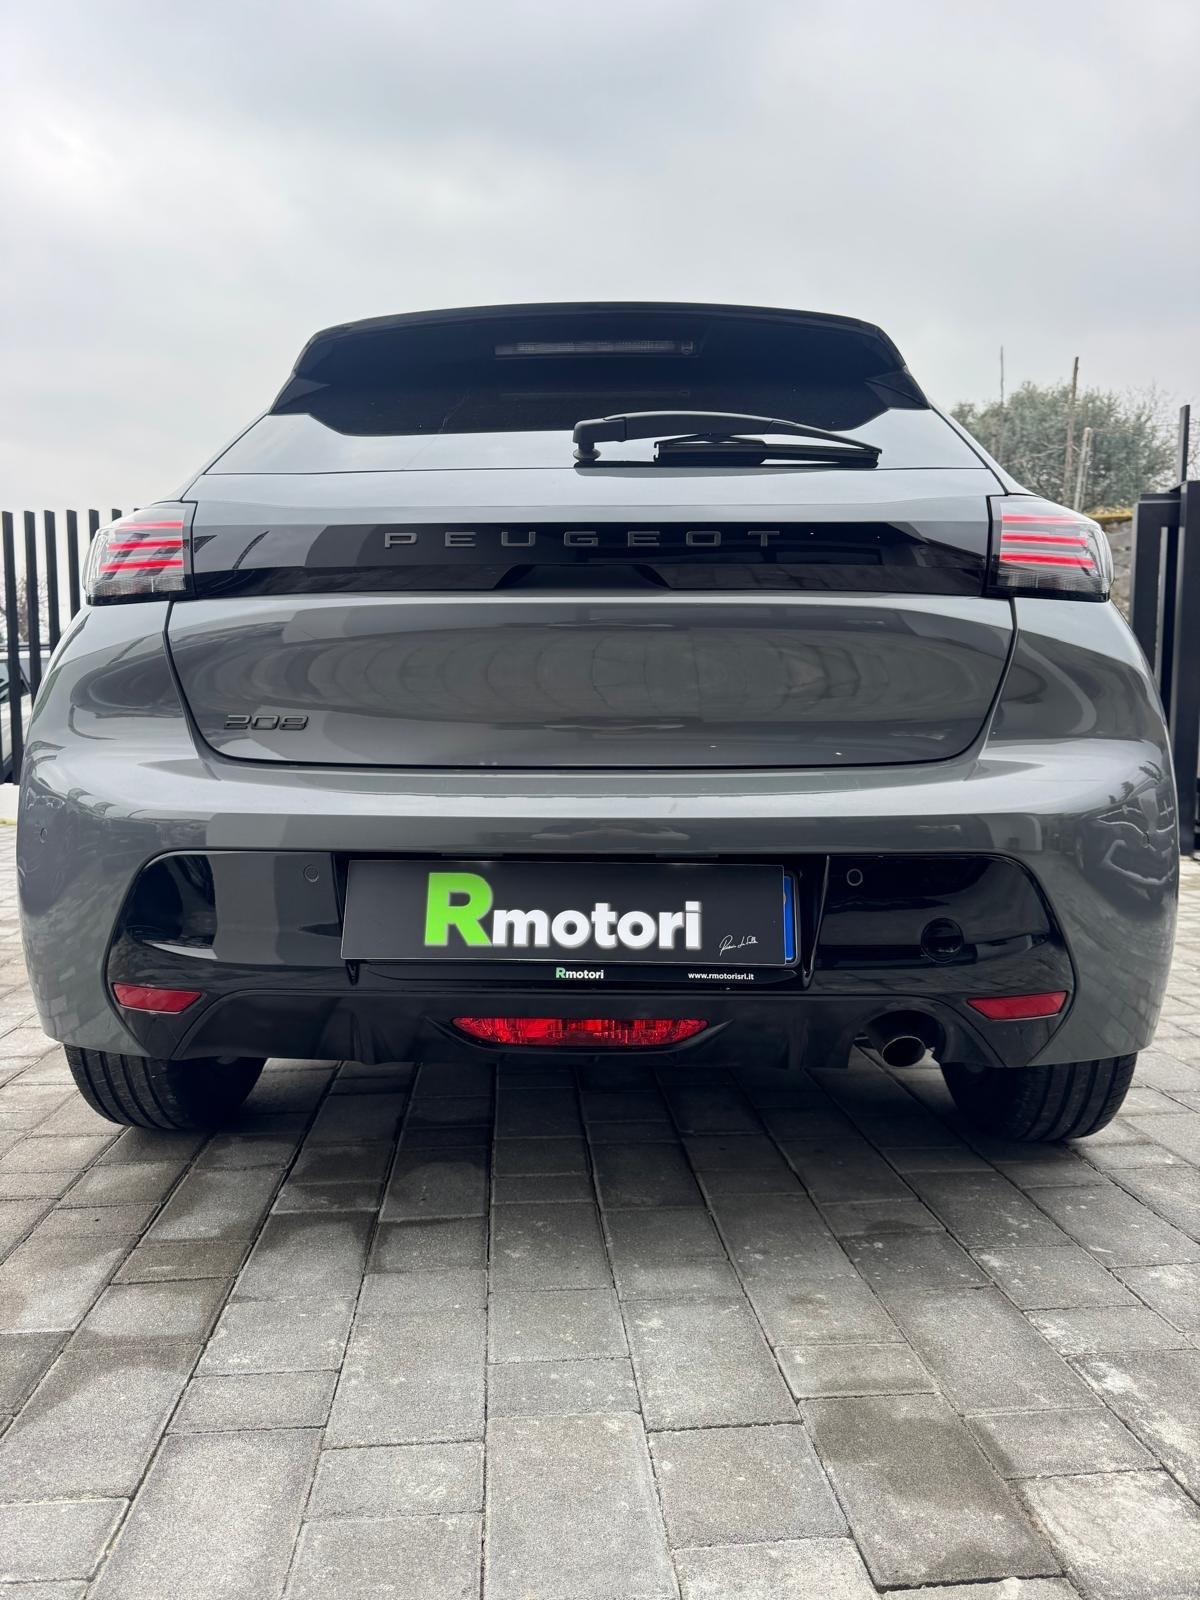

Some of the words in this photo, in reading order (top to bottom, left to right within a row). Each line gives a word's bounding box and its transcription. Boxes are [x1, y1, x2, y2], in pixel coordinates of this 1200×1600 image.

[384, 530, 780, 549] PEUGEOT
[224, 714, 309, 731] 208
[424, 872, 701, 950] Rmotori
[555, 966, 604, 979] Rmotori
[687, 972, 755, 981] www.rmotorisrl.it
